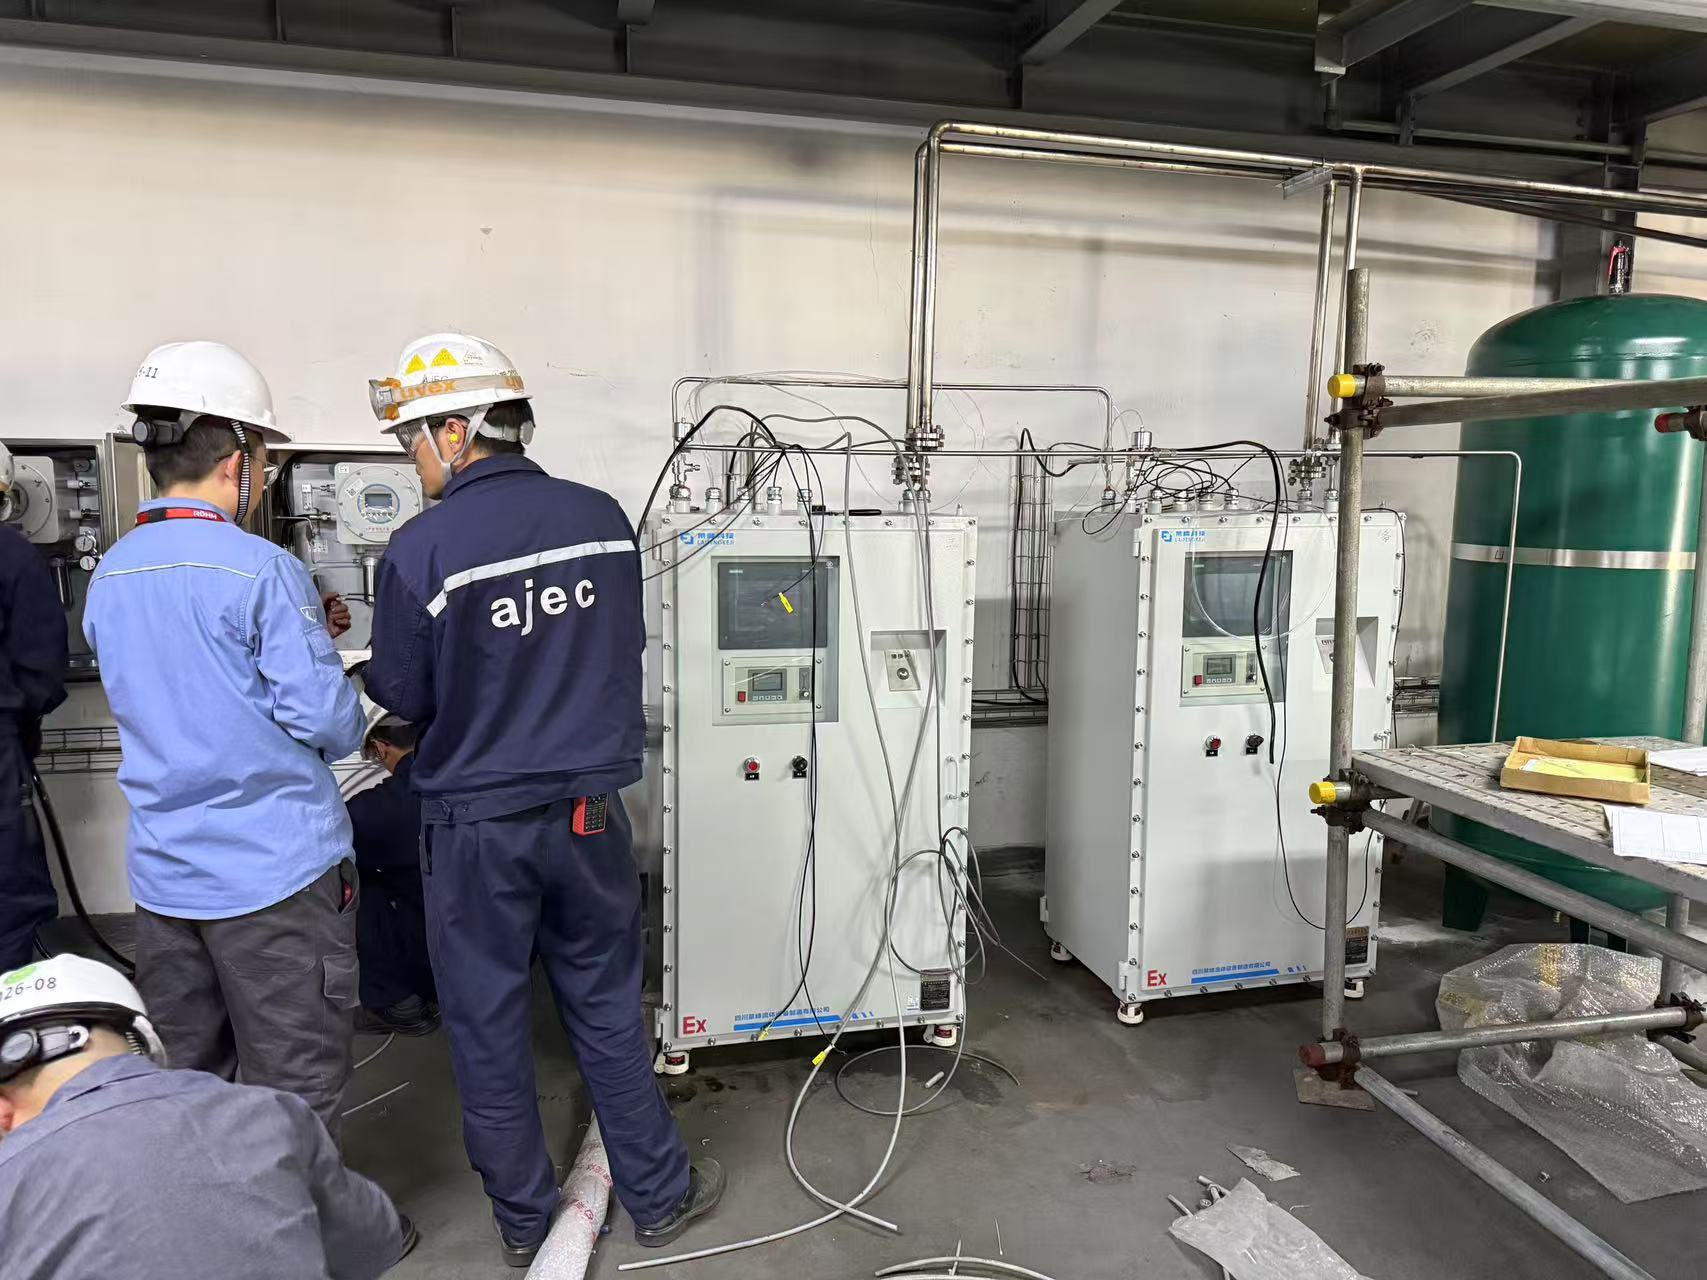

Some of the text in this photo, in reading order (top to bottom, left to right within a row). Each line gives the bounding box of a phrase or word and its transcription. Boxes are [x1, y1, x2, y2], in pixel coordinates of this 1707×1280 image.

[400, 381, 455, 400] uvex
[490, 578, 595, 637] ajec
[1147, 969, 1167, 987] Ex
[0, 976, 57, 1001] 26-08
[682, 1015, 707, 1035] Ex
